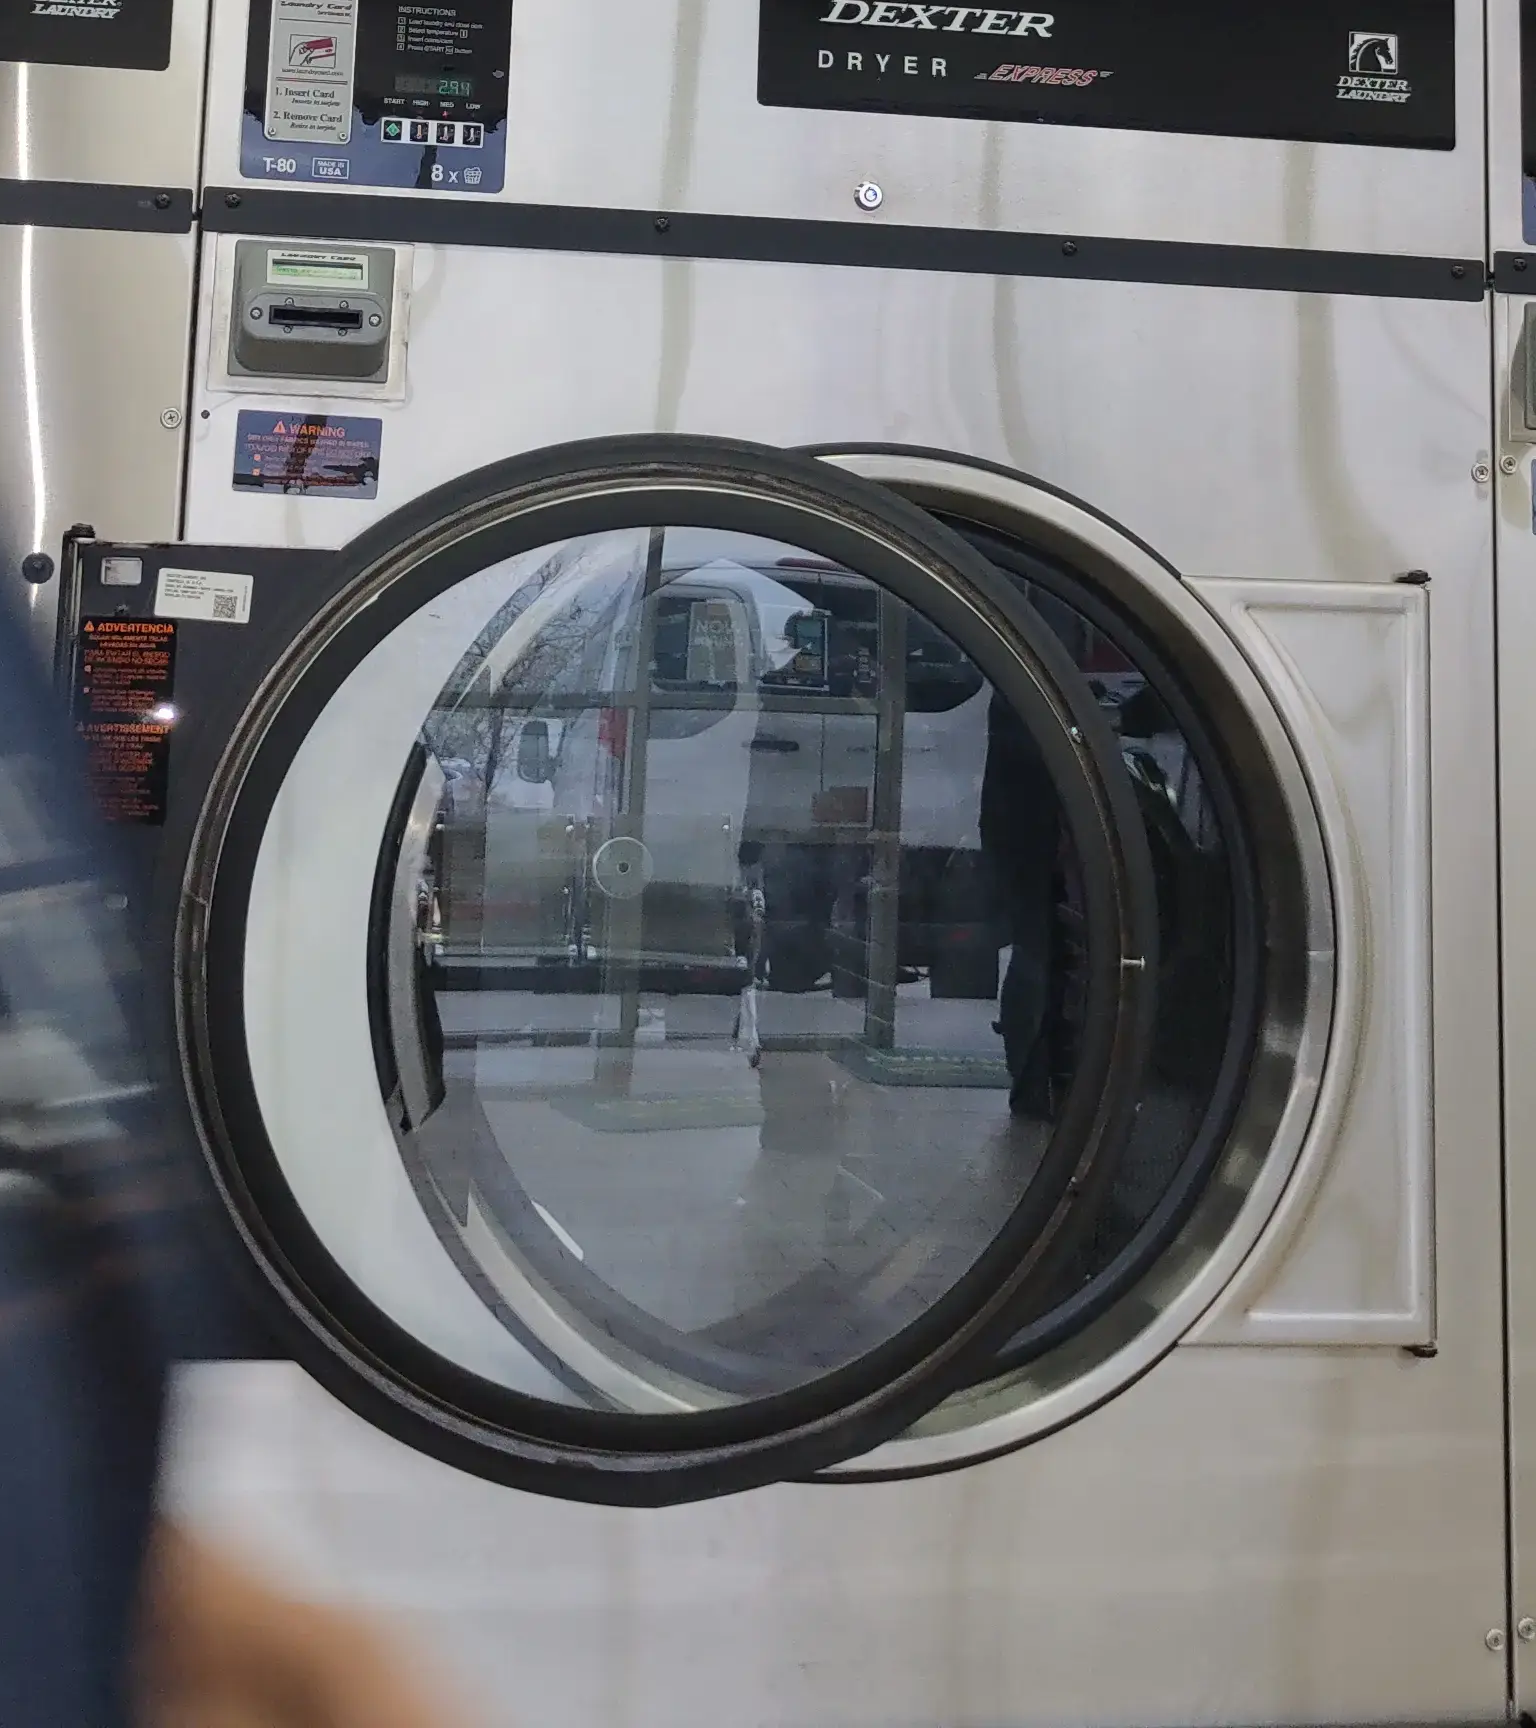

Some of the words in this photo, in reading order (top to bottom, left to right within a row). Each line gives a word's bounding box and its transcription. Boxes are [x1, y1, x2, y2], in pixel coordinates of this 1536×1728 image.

[30, 3, 121, 19] LAUNDRY
[280, 0, 324, 10] Laundry
[398, 5, 456, 16] INSTRUCTIONS
[818, 49, 947, 77] DRYER
[988, 63, 1100, 87] EXPRESS
[1336, 75, 1409, 91] DEXTER
[284, 87, 311, 98] Insert
[312, 89, 335, 99] Card
[283, 111, 318, 122] Remove
[319, 113, 343, 123] Card
[262, 157, 297, 174] T-80
[319, 167, 343, 177] USA
[430, 164, 444, 182] 8
[289, 423, 346, 438] WARNING
[97, 622, 175, 634] ADVERTENCIA
